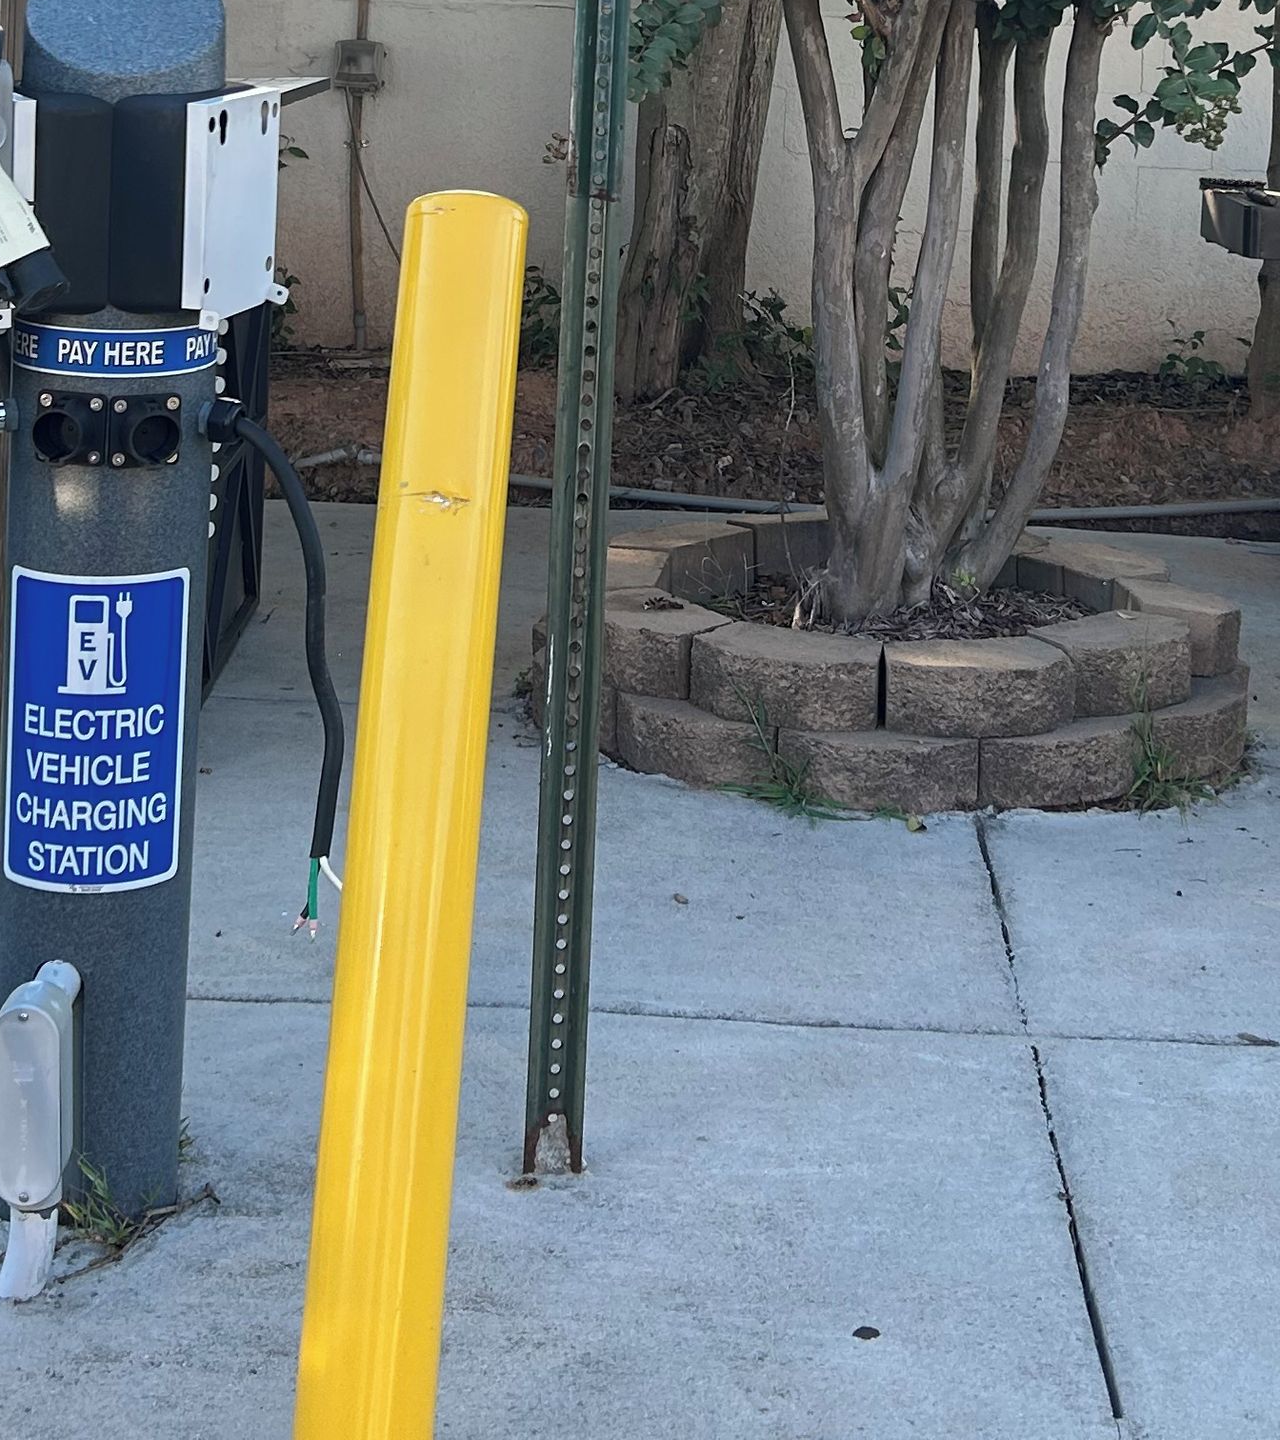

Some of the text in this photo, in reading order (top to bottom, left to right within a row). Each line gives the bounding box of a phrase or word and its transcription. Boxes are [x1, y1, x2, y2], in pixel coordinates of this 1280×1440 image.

[16, 330, 39, 359] ERE
[57, 338, 165, 366] PAY HERE
[185, 333, 211, 361] PAY
[23, 702, 166, 741] ELECTRIC
[26, 748, 152, 786] VEHICLE
[16, 792, 168, 832] CHARGING
[27, 839, 150, 877] STATION
